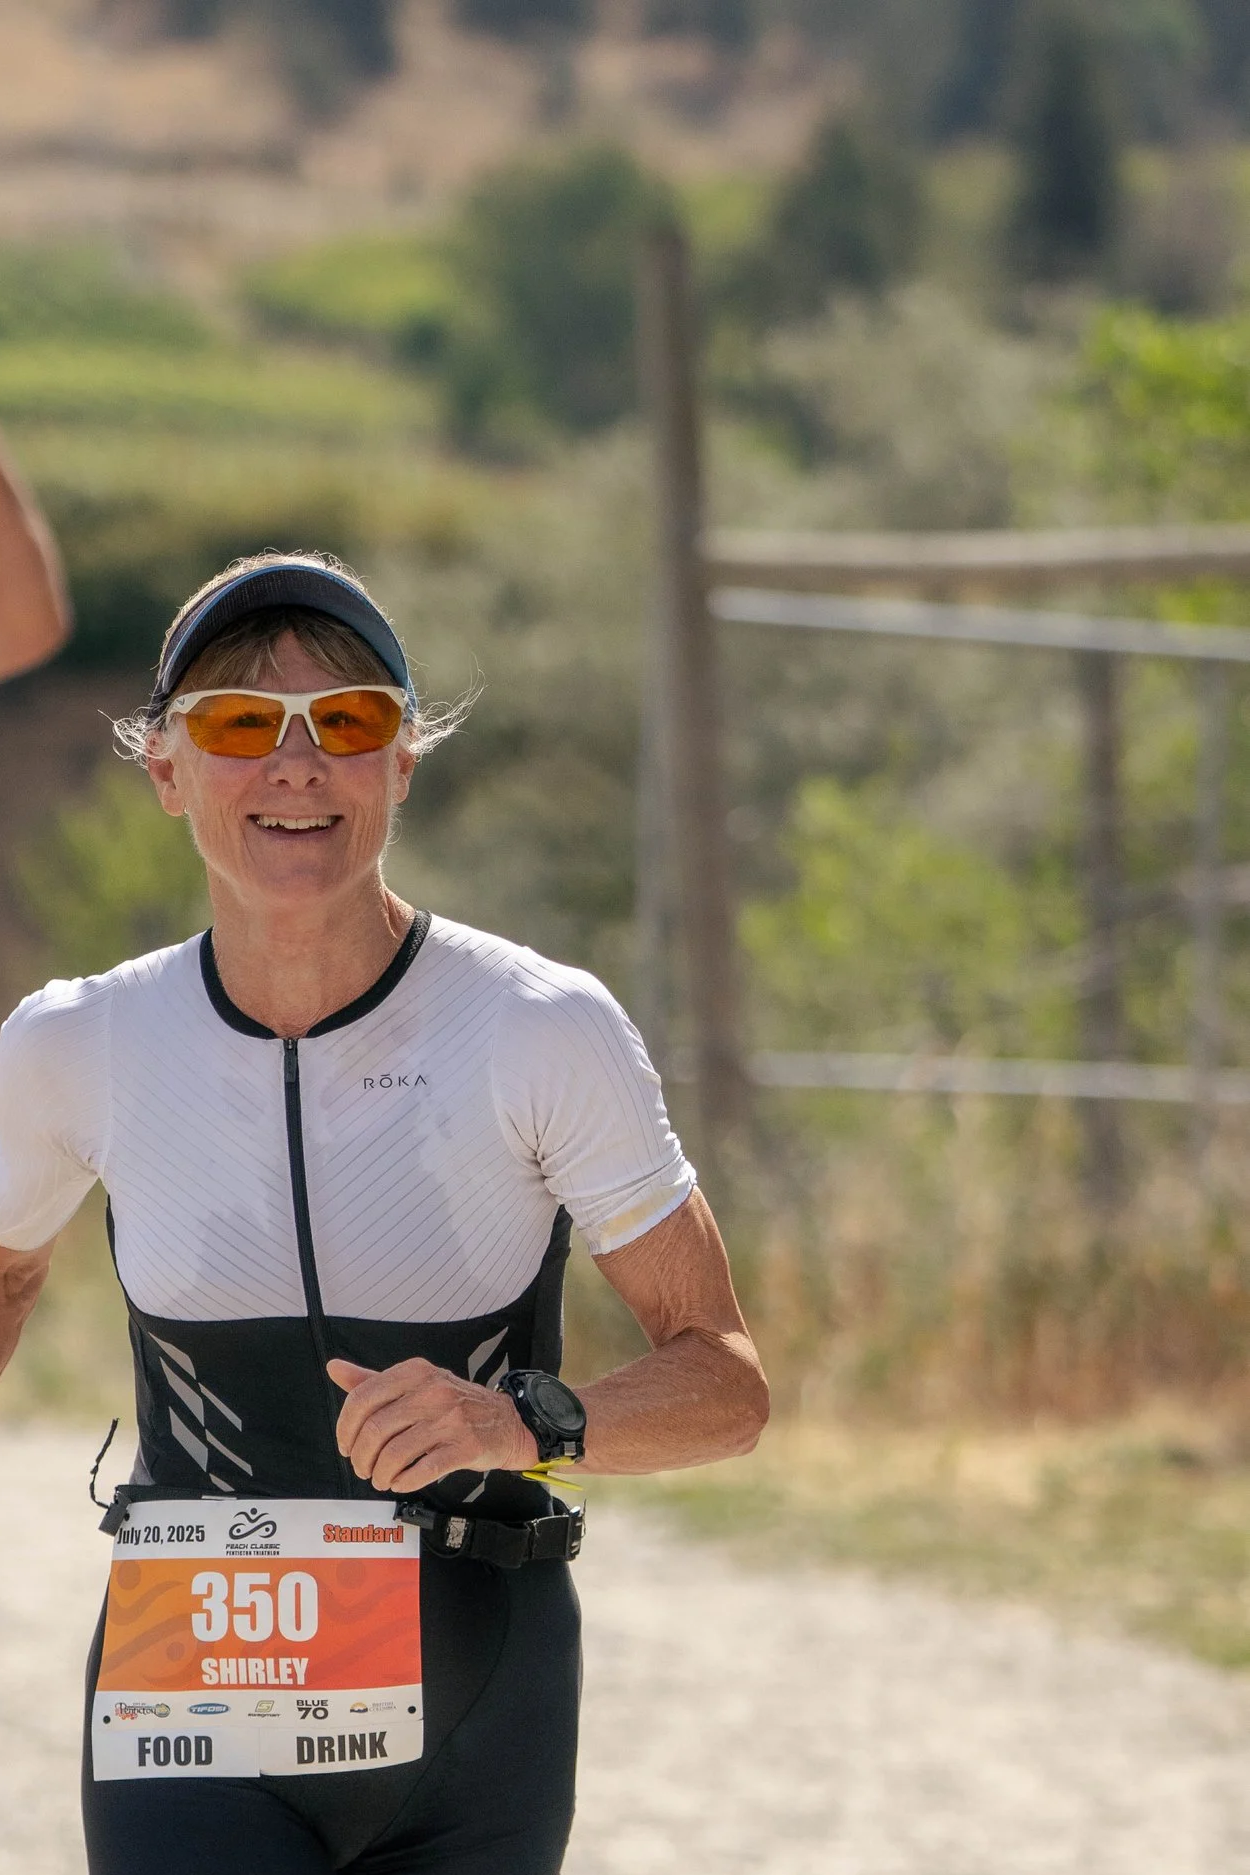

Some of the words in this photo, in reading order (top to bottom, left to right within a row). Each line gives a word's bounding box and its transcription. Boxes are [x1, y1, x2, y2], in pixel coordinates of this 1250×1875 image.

[117, 1527, 141, 1546] July
[143, 1525, 164, 1545] 20,
[167, 1524, 205, 1543] 2025
[323, 1523, 404, 1543] Standard
[191, 1571, 319, 1642] 350
[201, 1657, 309, 1686] SHIRLEY
[296, 1699, 329, 1707] BLUE
[297, 1707, 329, 1720] 70
[137, 1735, 213, 1767] FOOD
[296, 1731, 388, 1765] DRINK
